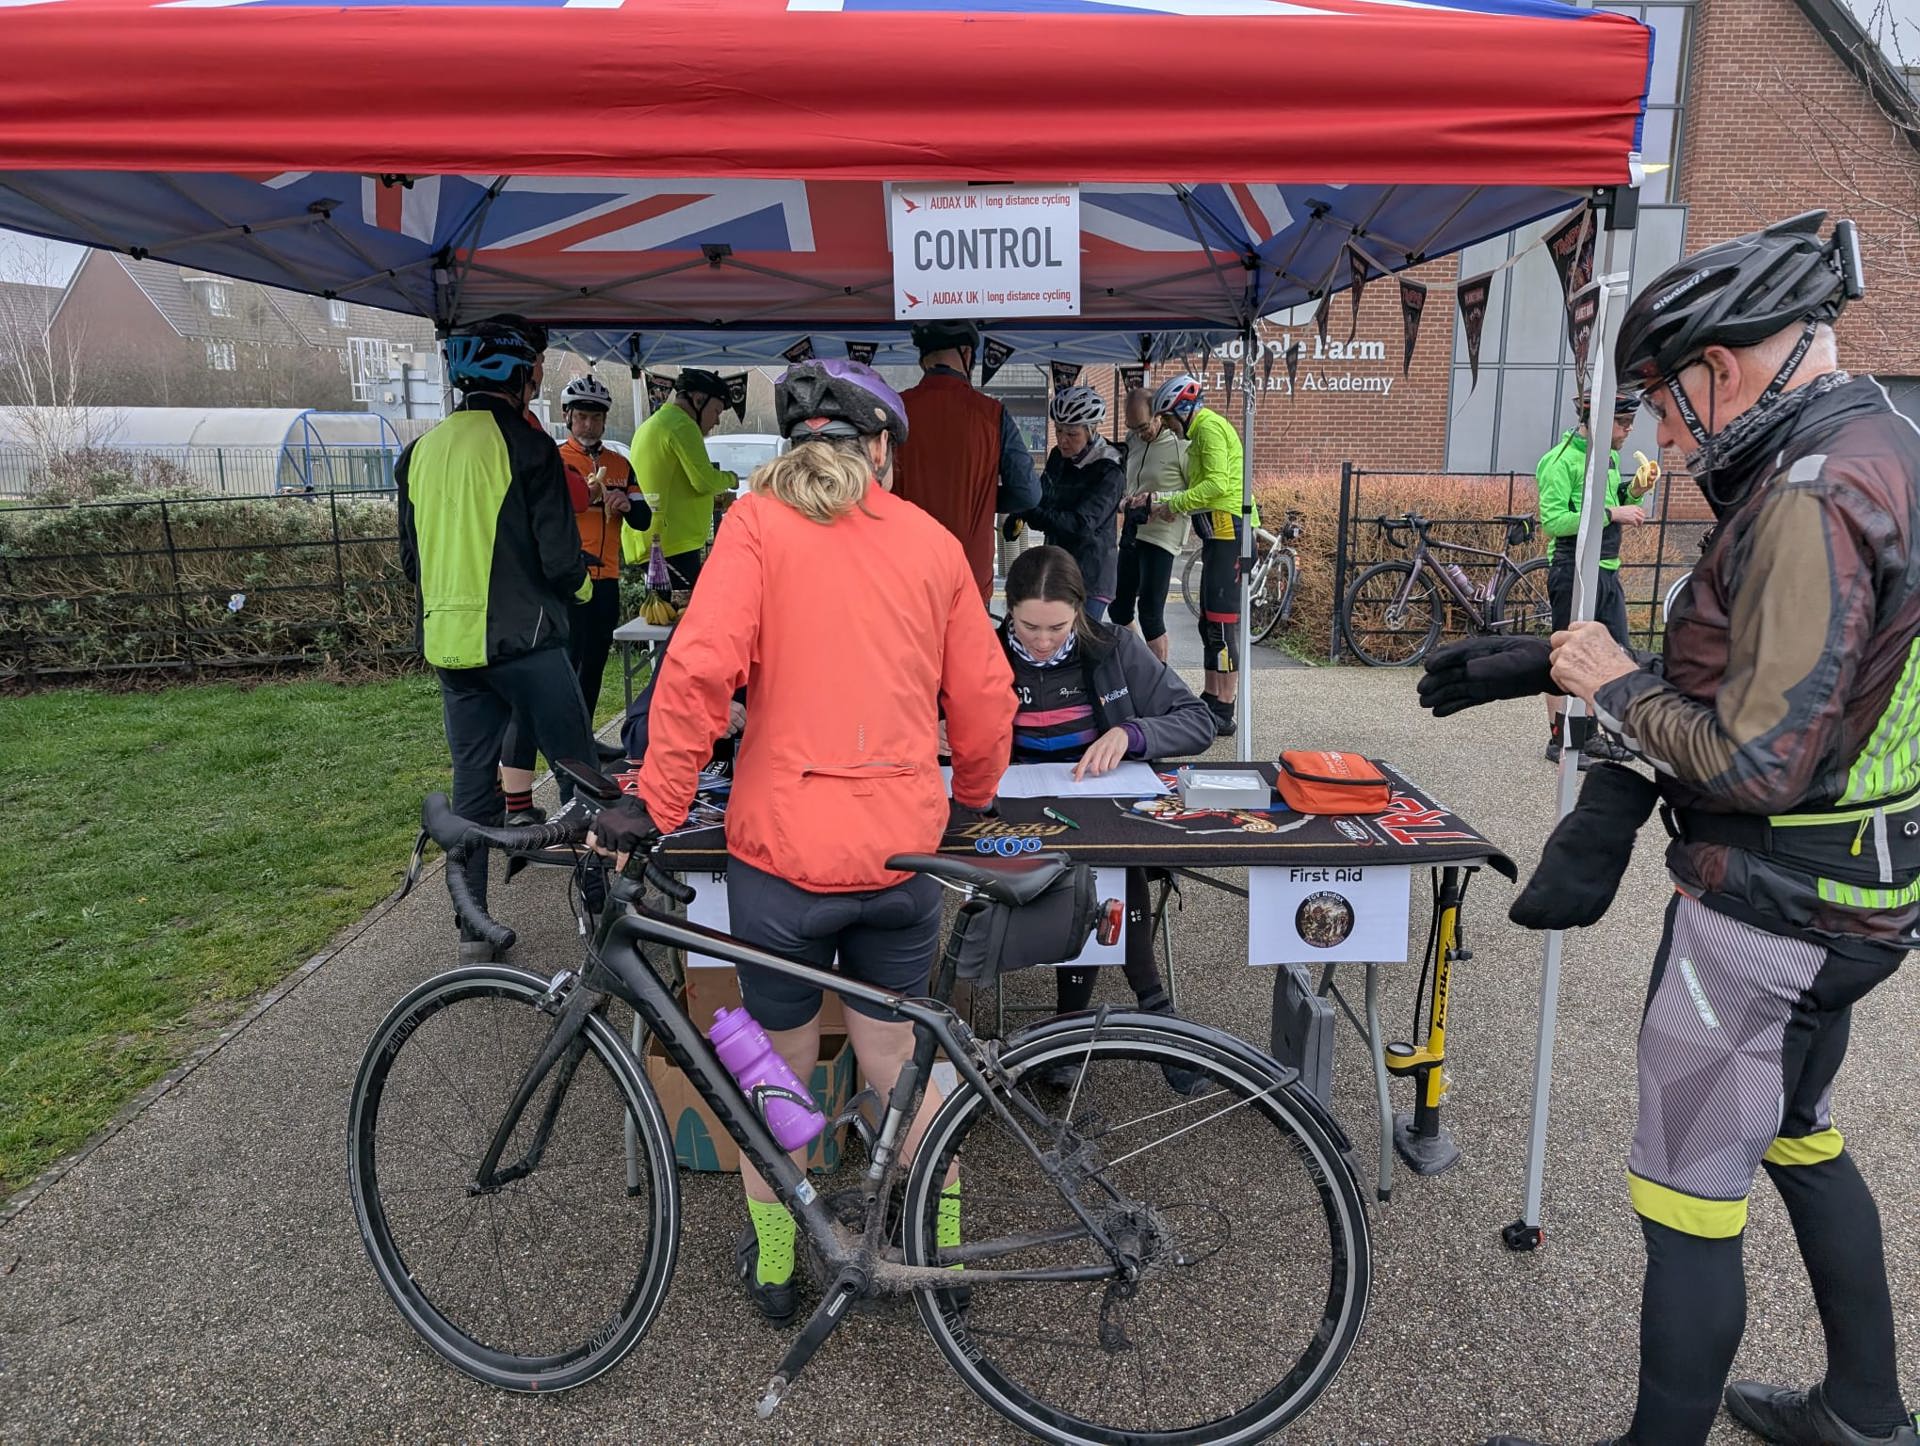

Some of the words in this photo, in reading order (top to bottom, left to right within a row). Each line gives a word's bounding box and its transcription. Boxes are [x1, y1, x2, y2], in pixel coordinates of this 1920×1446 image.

[930, 195, 961, 210] AUDAX
[964, 195, 977, 209] UK
[985, 195, 1003, 208] long
[1005, 194, 1040, 206] distance
[1041, 193, 1071, 207] cycling
[914, 226, 1062, 271] CONTROL
[932, 290, 963, 305] AUDAX
[966, 291, 979, 304] UK
[987, 290, 1004, 304] long
[1006, 289, 1040, 301] distance
[1042, 288, 1071, 303] cycling
[1312, 334, 1386, 360] Farm
[1301, 372, 1394, 395] Academy
[1290, 868, 1330, 883] First
[1335, 867, 1364, 882] Aid
[390, 1011, 421, 1046] HUNT
[587, 1321, 618, 1355] HUNT
[940, 1311, 975, 1353] HUNT
